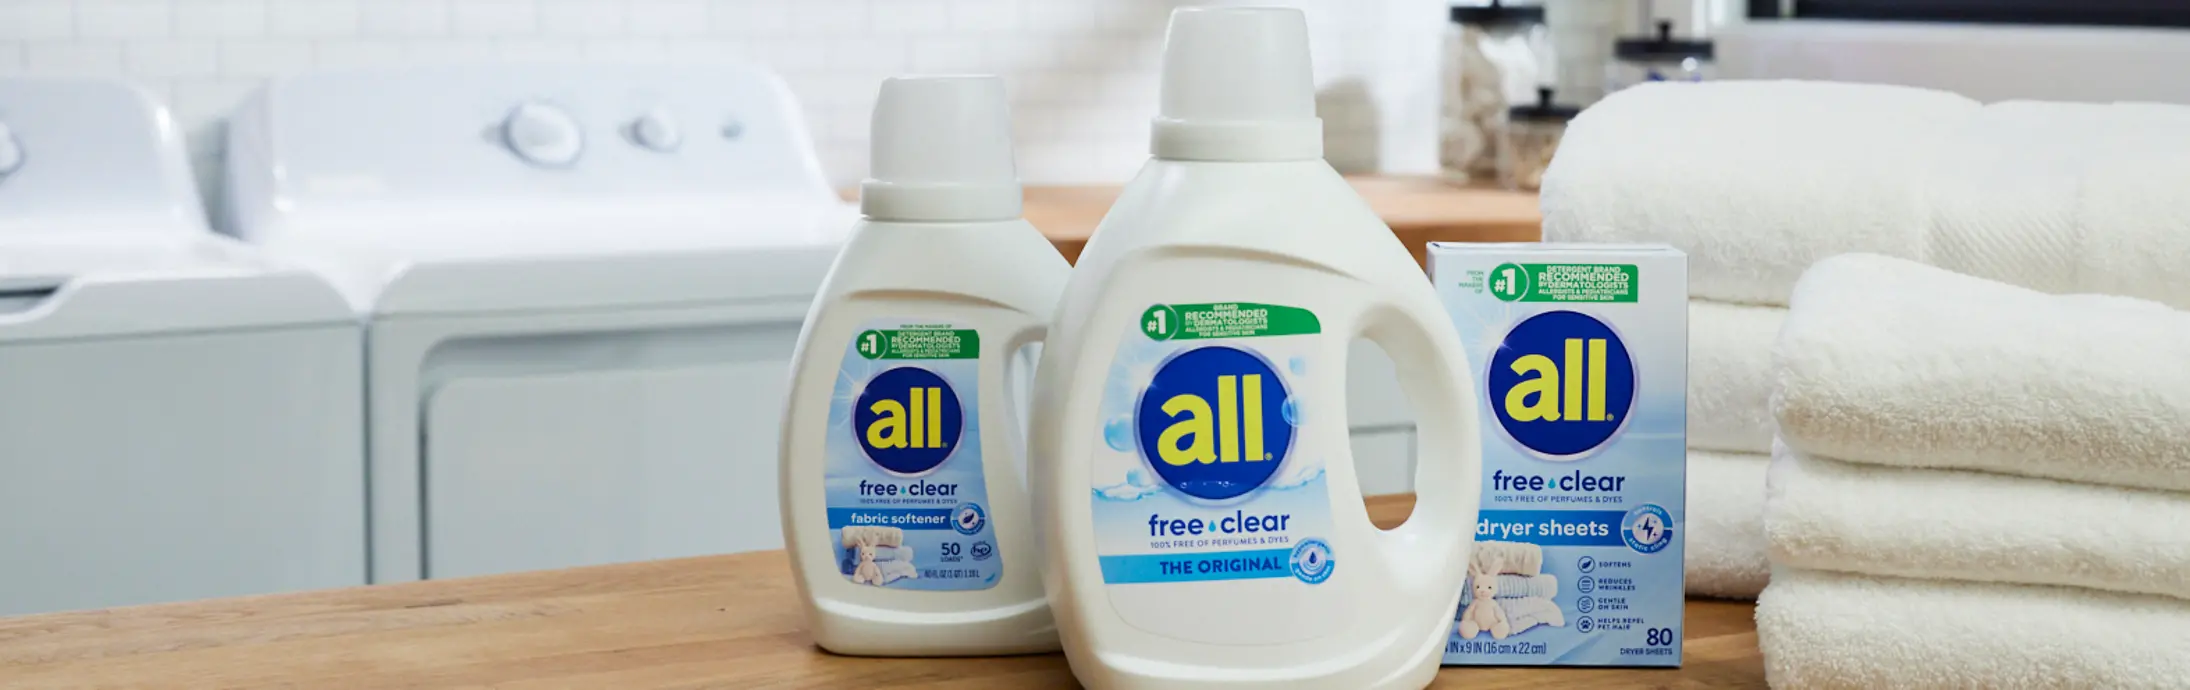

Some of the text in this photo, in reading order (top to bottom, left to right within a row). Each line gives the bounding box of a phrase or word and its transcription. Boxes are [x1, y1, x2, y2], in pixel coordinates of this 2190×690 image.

[1494, 268, 1516, 295] #1
[1538, 273, 1629, 282] RECOMMENDED
[1147, 310, 1166, 334] #1
[1184, 308, 1268, 320] RECOMMENDED
[1194, 318, 1268, 326] DERMATOLOGISTS
[861, 334, 877, 354] #1
[859, 480, 958, 496] free clear
[1493, 470, 1626, 492] free clear
[851, 513, 946, 524] fabric softener
[1149, 510, 1290, 536] free clear
[1476, 518, 1609, 539] dryer sheets
[942, 542, 960, 556] 50
[1212, 538, 1258, 546] PERFUMES
[1160, 556, 1282, 574] THE ORIGINAL
[1646, 628, 1672, 646] 80
[1450, 642, 1458, 654] IN
[1460, 646, 1464, 654] x
[1466, 642, 1472, 654] 9
[1473, 642, 1482, 654] IN
[1484, 642, 1497, 654] (16
[1498, 646, 1511, 654] cm
[1512, 646, 1516, 654] x
[1518, 642, 1530, 654] 22
[1532, 642, 1546, 655] cm)
